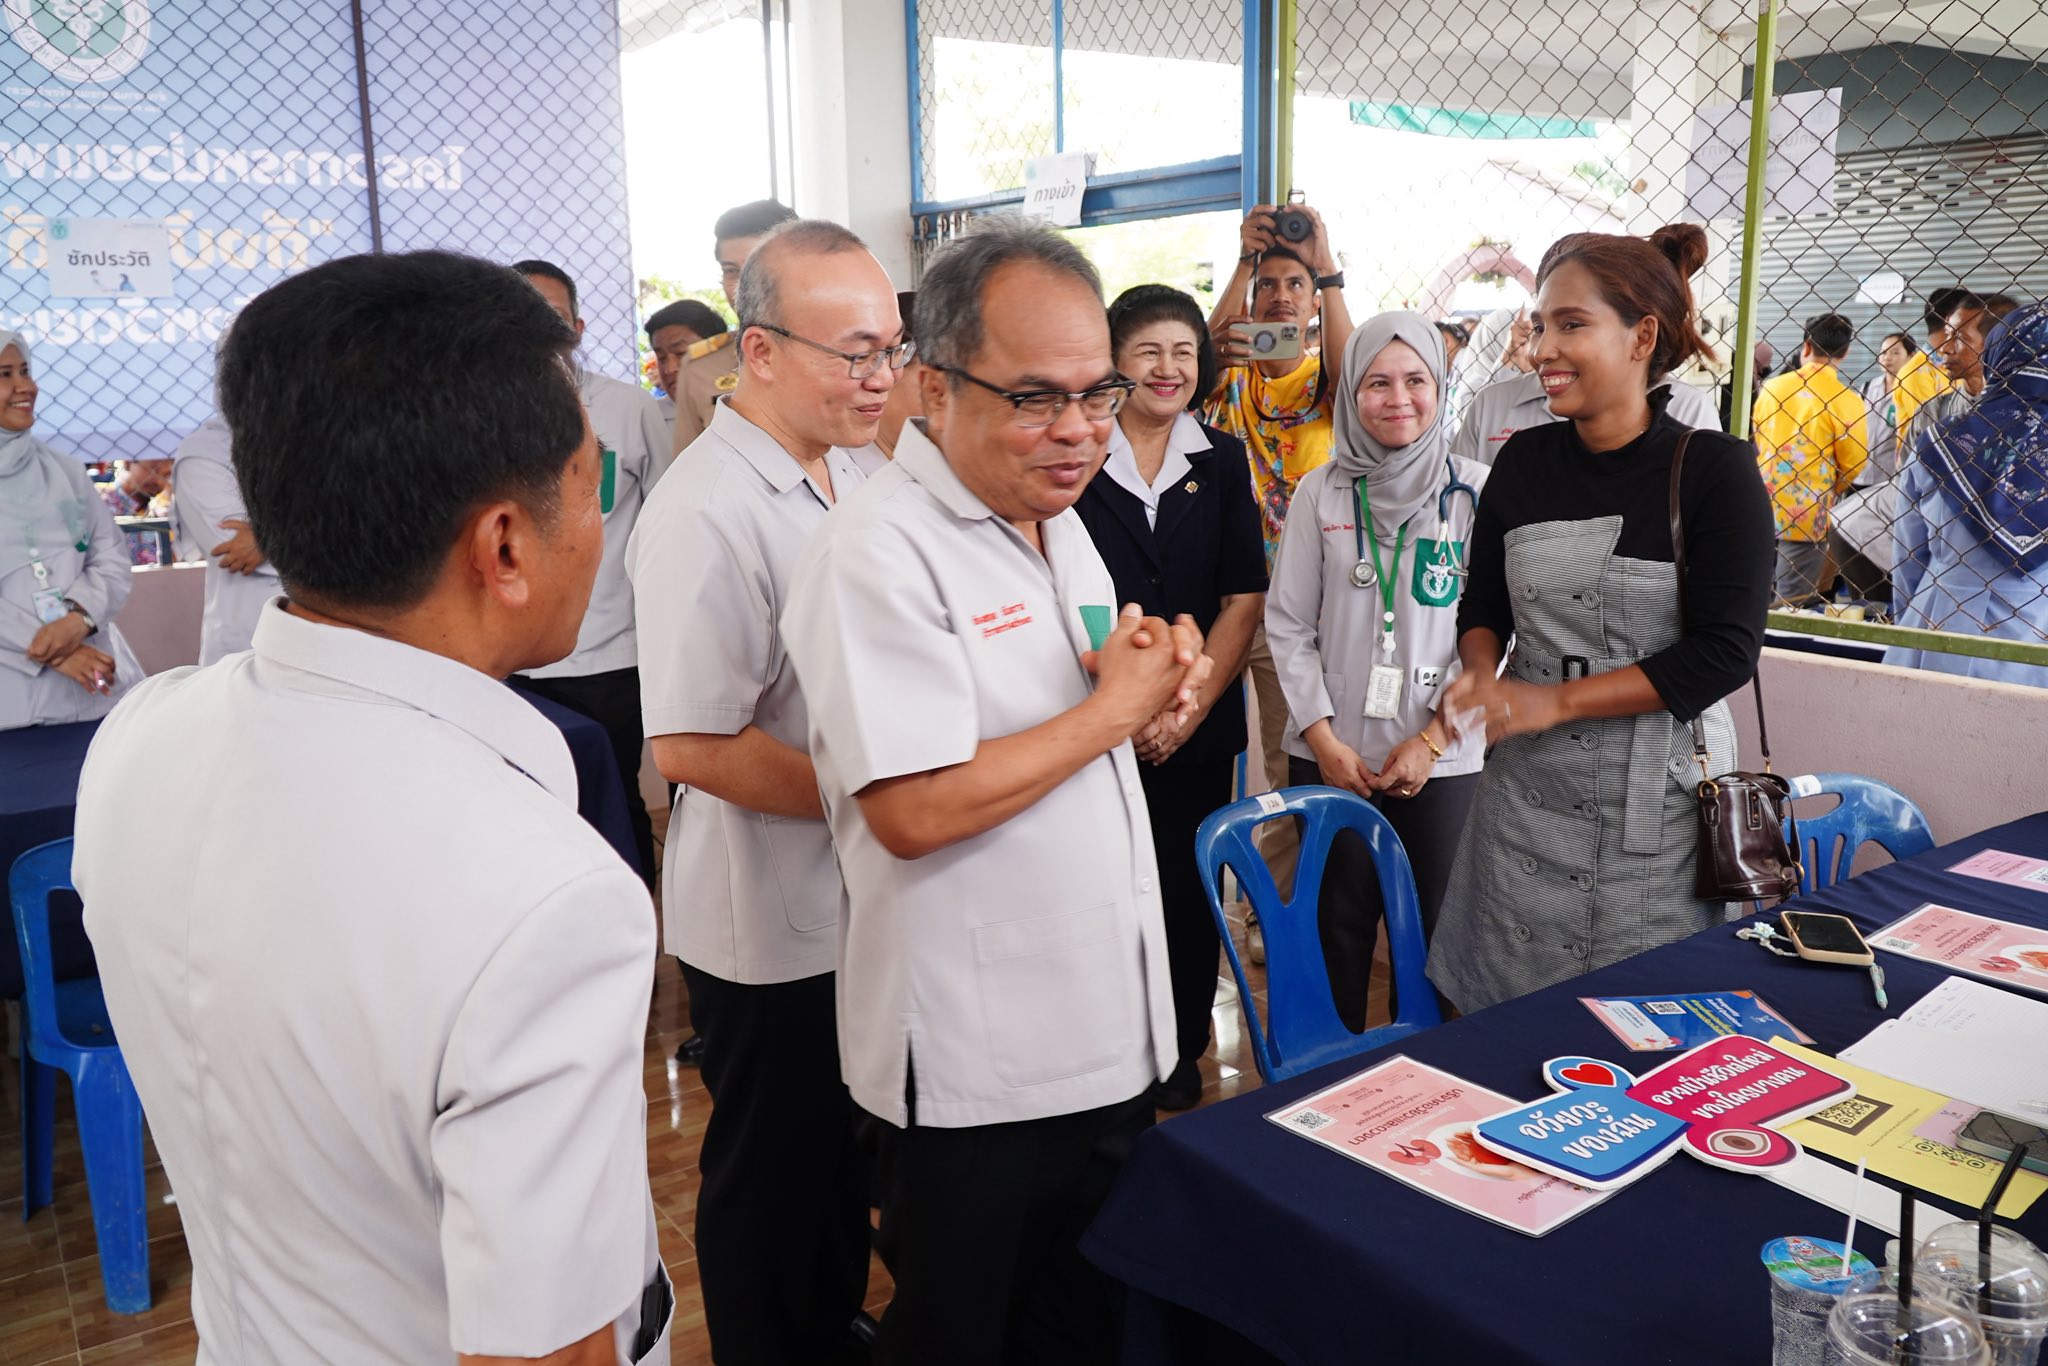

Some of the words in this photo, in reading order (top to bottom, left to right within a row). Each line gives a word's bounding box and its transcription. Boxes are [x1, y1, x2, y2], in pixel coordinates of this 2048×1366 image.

[1033, 178, 1076, 202] ทางเข้า
[67, 248, 150, 267] ซักประวัติ
[1651, 1048, 1776, 1106] อาจเป็นชีวิตใหม่
[1691, 1066, 1807, 1119] ของใครบางคน
[1348, 1088, 1464, 1146] บริจาคอวัยวะและดวงตา
[1519, 1101, 1609, 1140] อวัยวะ
[1562, 1113, 1657, 1159] ของฉัน
